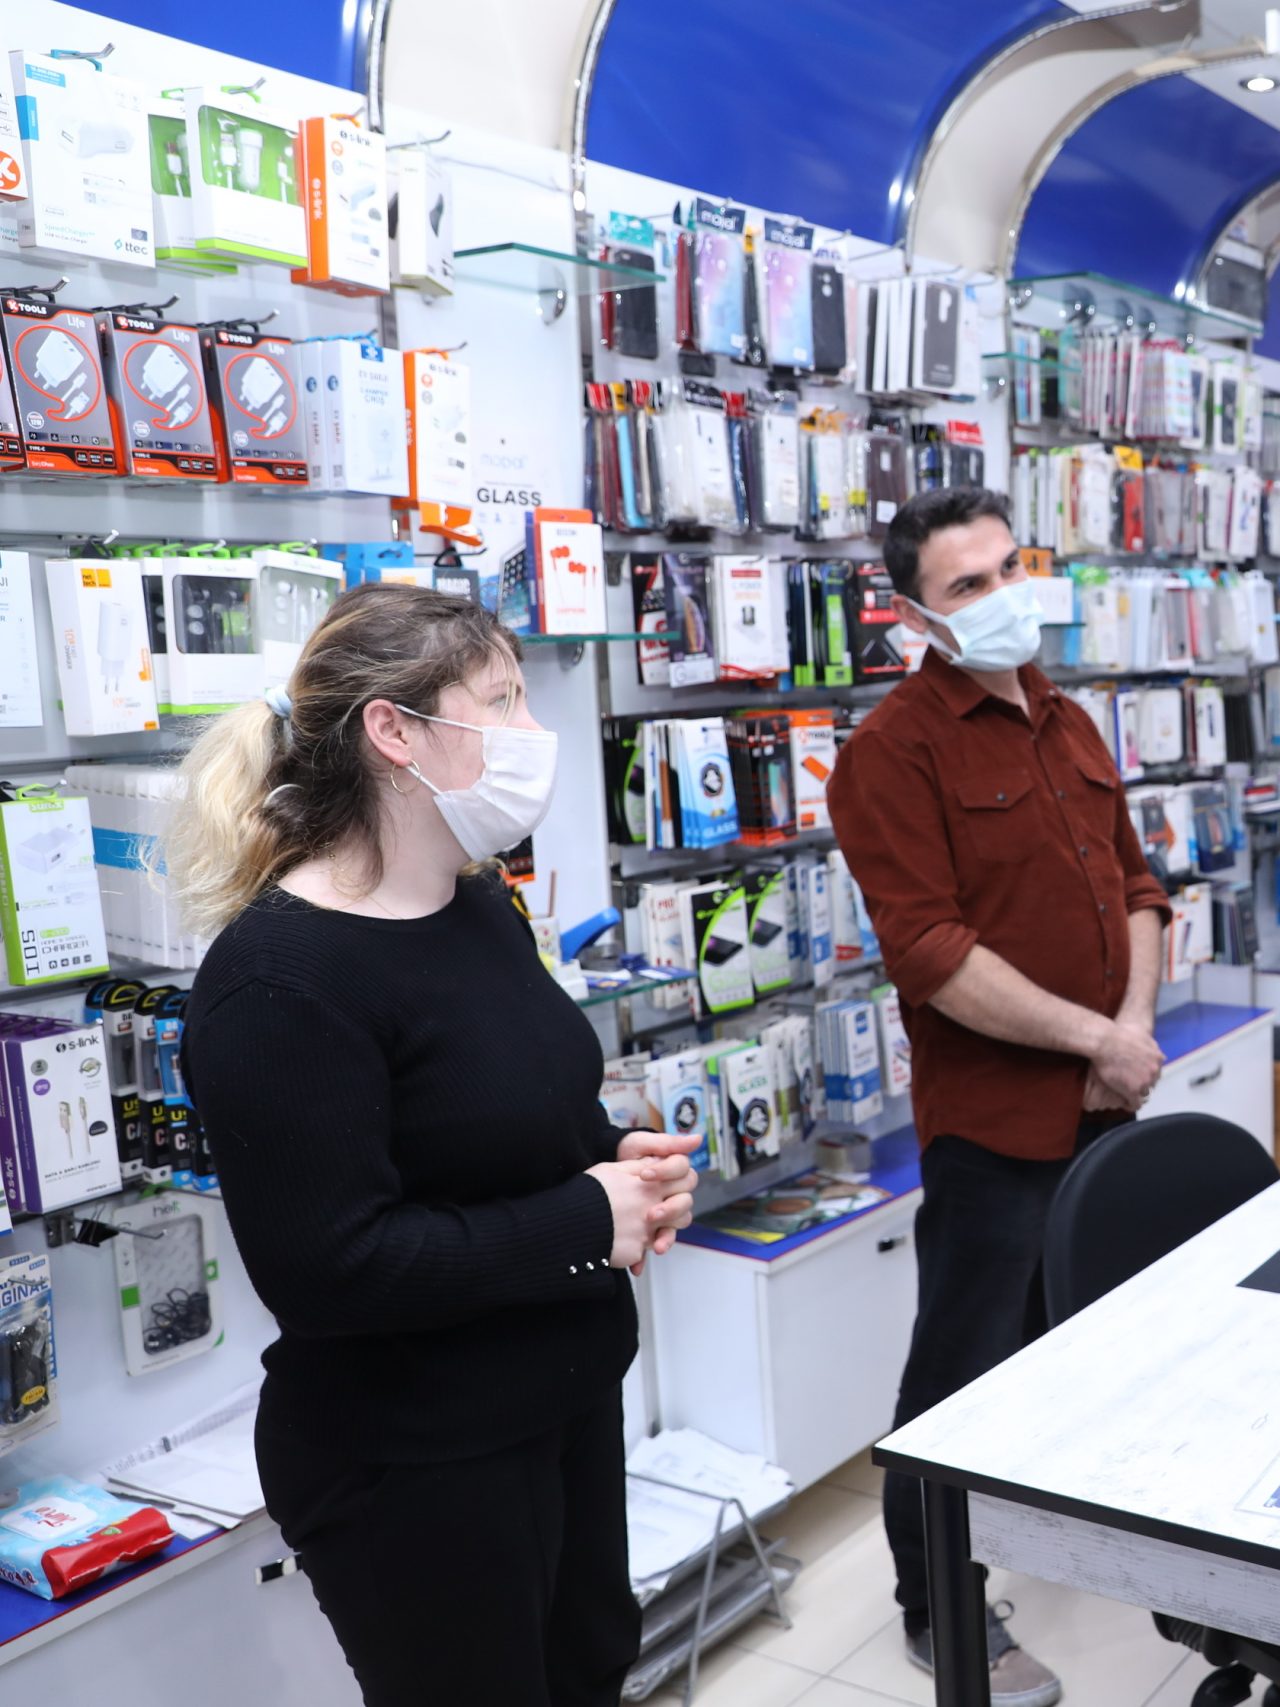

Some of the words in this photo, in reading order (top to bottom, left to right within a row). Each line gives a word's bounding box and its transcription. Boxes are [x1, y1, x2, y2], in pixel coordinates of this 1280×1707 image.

[125, 241, 149, 256] ttec
[19, 303, 47, 315] TOOLS
[67, 315, 86, 328] Life
[128, 319, 155, 331] TOOLS
[173, 330, 190, 343] Life
[477, 487, 542, 507] GLASS
[69, 1034, 99, 1051] s-link
[5, 1156, 15, 1187] s-link
